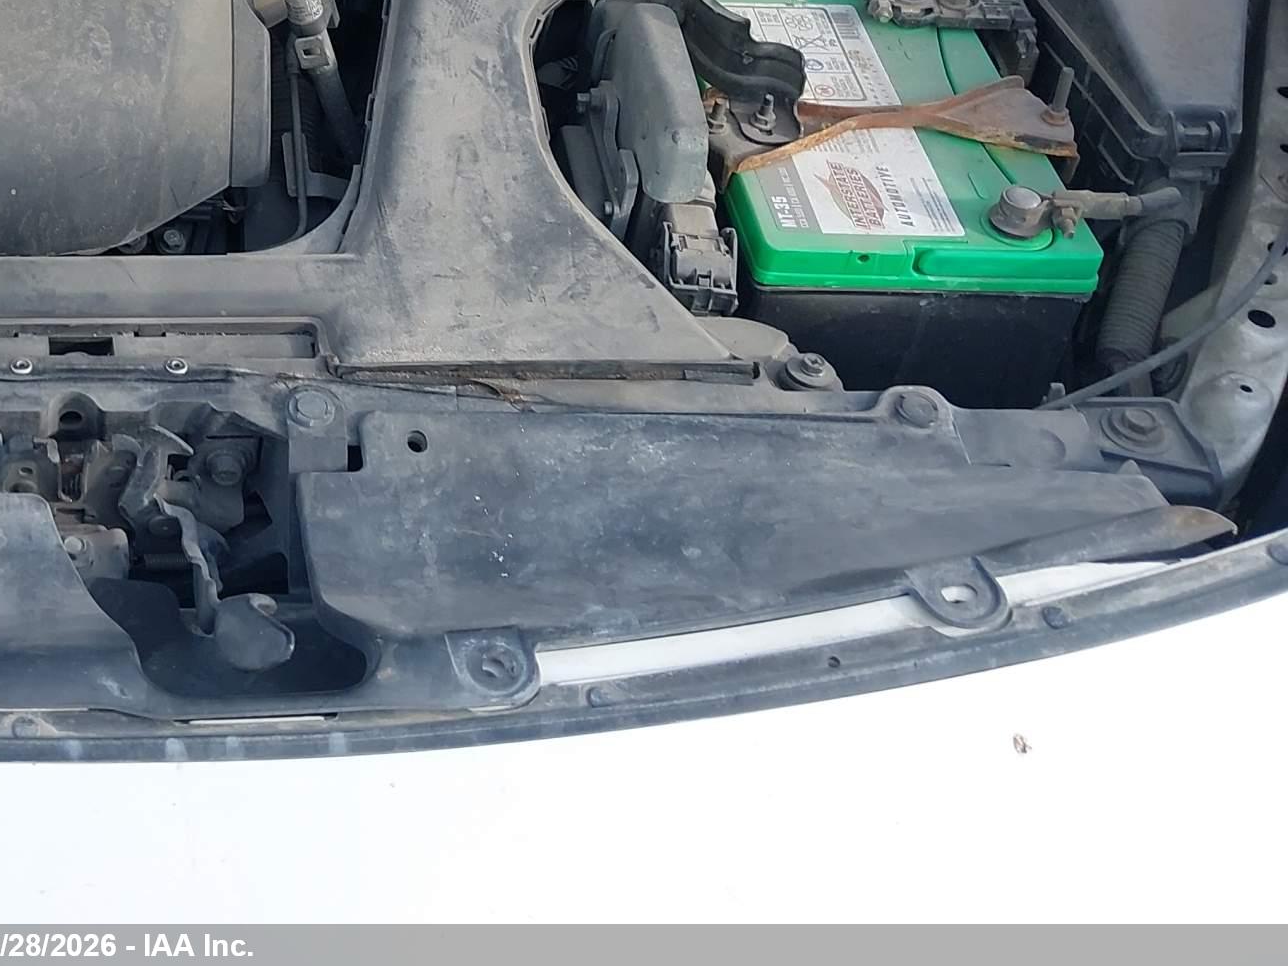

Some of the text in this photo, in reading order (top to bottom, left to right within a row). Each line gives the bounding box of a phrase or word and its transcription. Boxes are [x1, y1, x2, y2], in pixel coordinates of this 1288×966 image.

[771, 195, 799, 228] MT-35
[829, 161, 867, 228] INTERSTATE
[845, 167, 882, 226] BATTERIES
[875, 166, 916, 227] AUTOMOTIVE
